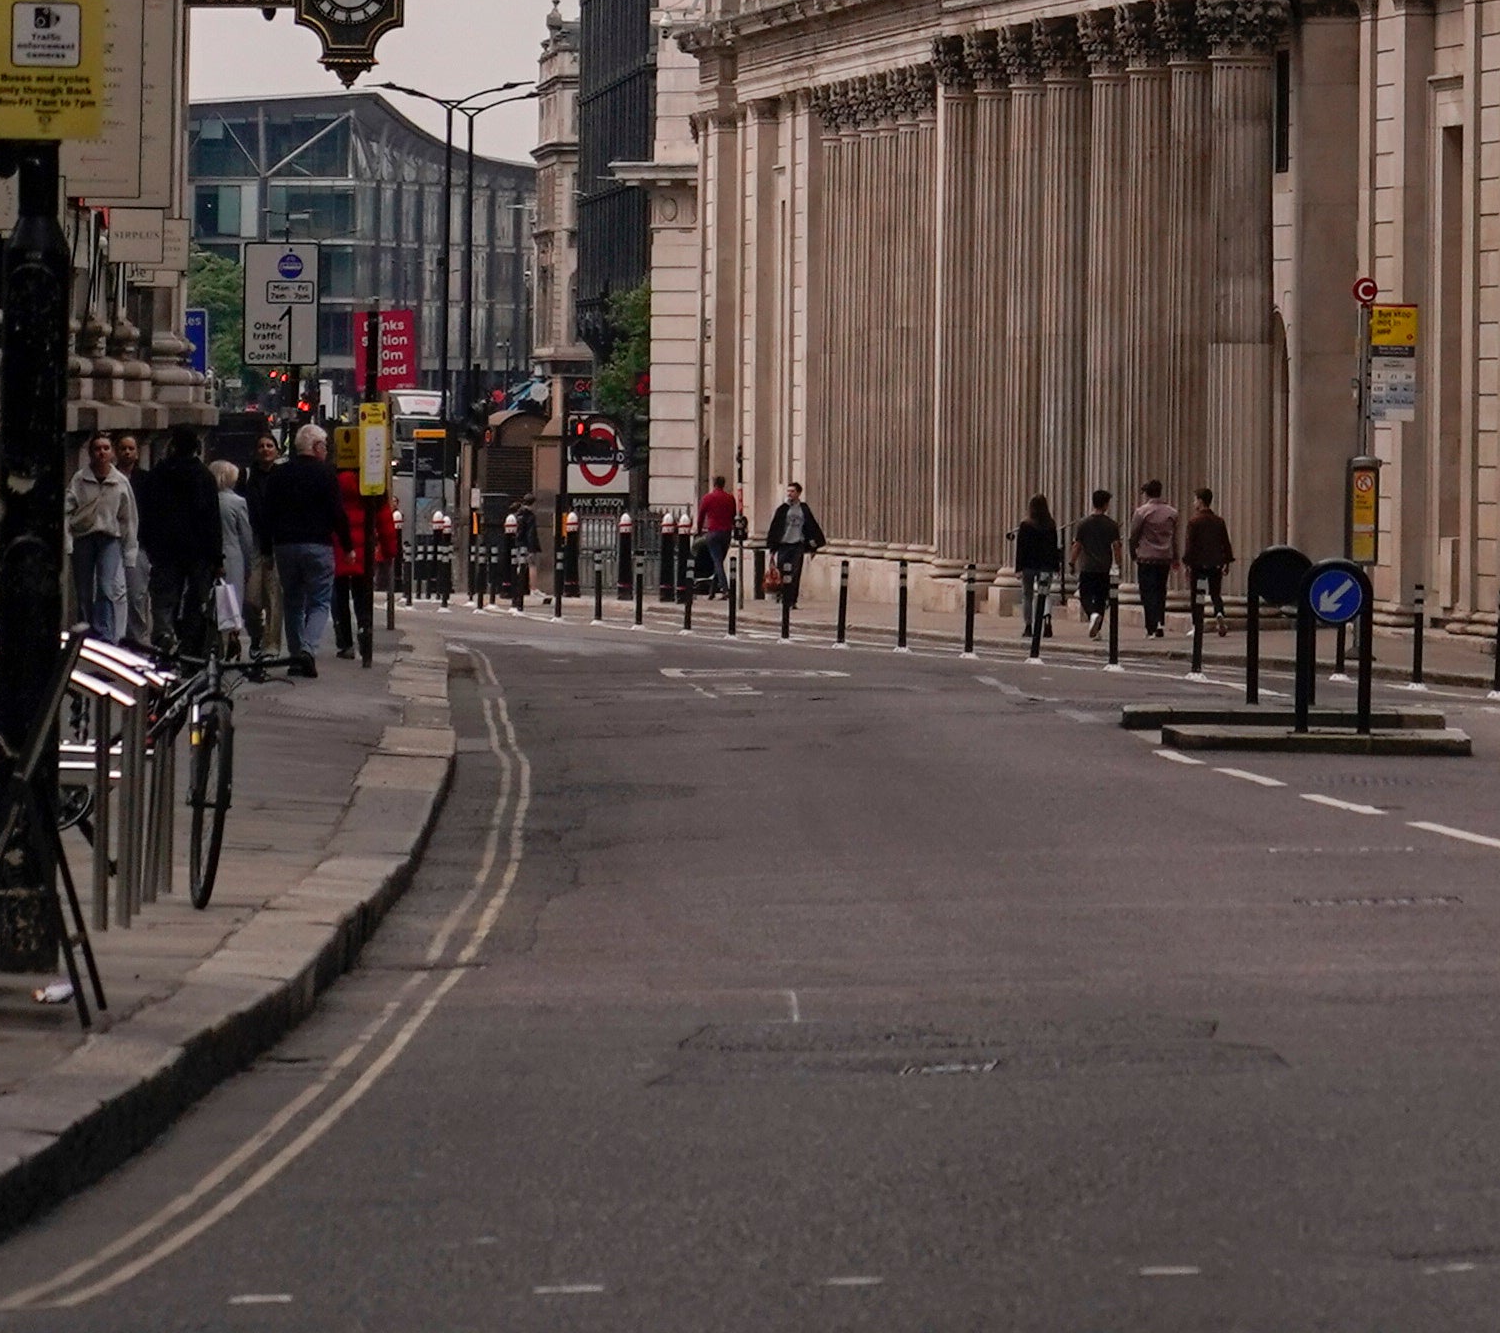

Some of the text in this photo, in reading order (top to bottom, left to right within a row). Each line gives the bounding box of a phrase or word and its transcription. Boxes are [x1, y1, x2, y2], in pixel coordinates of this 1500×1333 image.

[30, 33, 61, 42] Traffic
[16, 42, 75, 51] enforcement
[25, 52, 66, 60] cameras
[0, 74, 90, 85] Buses and cycles
[22, 86, 62, 97] through
[65, 87, 92, 96] Bank
[36, 98, 58, 107] 7am
[60, 99, 71, 108] to
[73, 99, 97, 110] 7pm
[113, 230, 161, 240] SIRPLUS
[272, 284, 289, 292] Mon
[297, 284, 309, 292] Fri
[1357, 281, 1374, 299] C
[294, 293, 311, 301] 7pm
[253, 321, 282, 331] Other
[252, 331, 283, 341] traffic
[258, 343, 276, 351] use
[247, 351, 287, 361] Cornhill
[572, 497, 625, 508] BANK STATION
